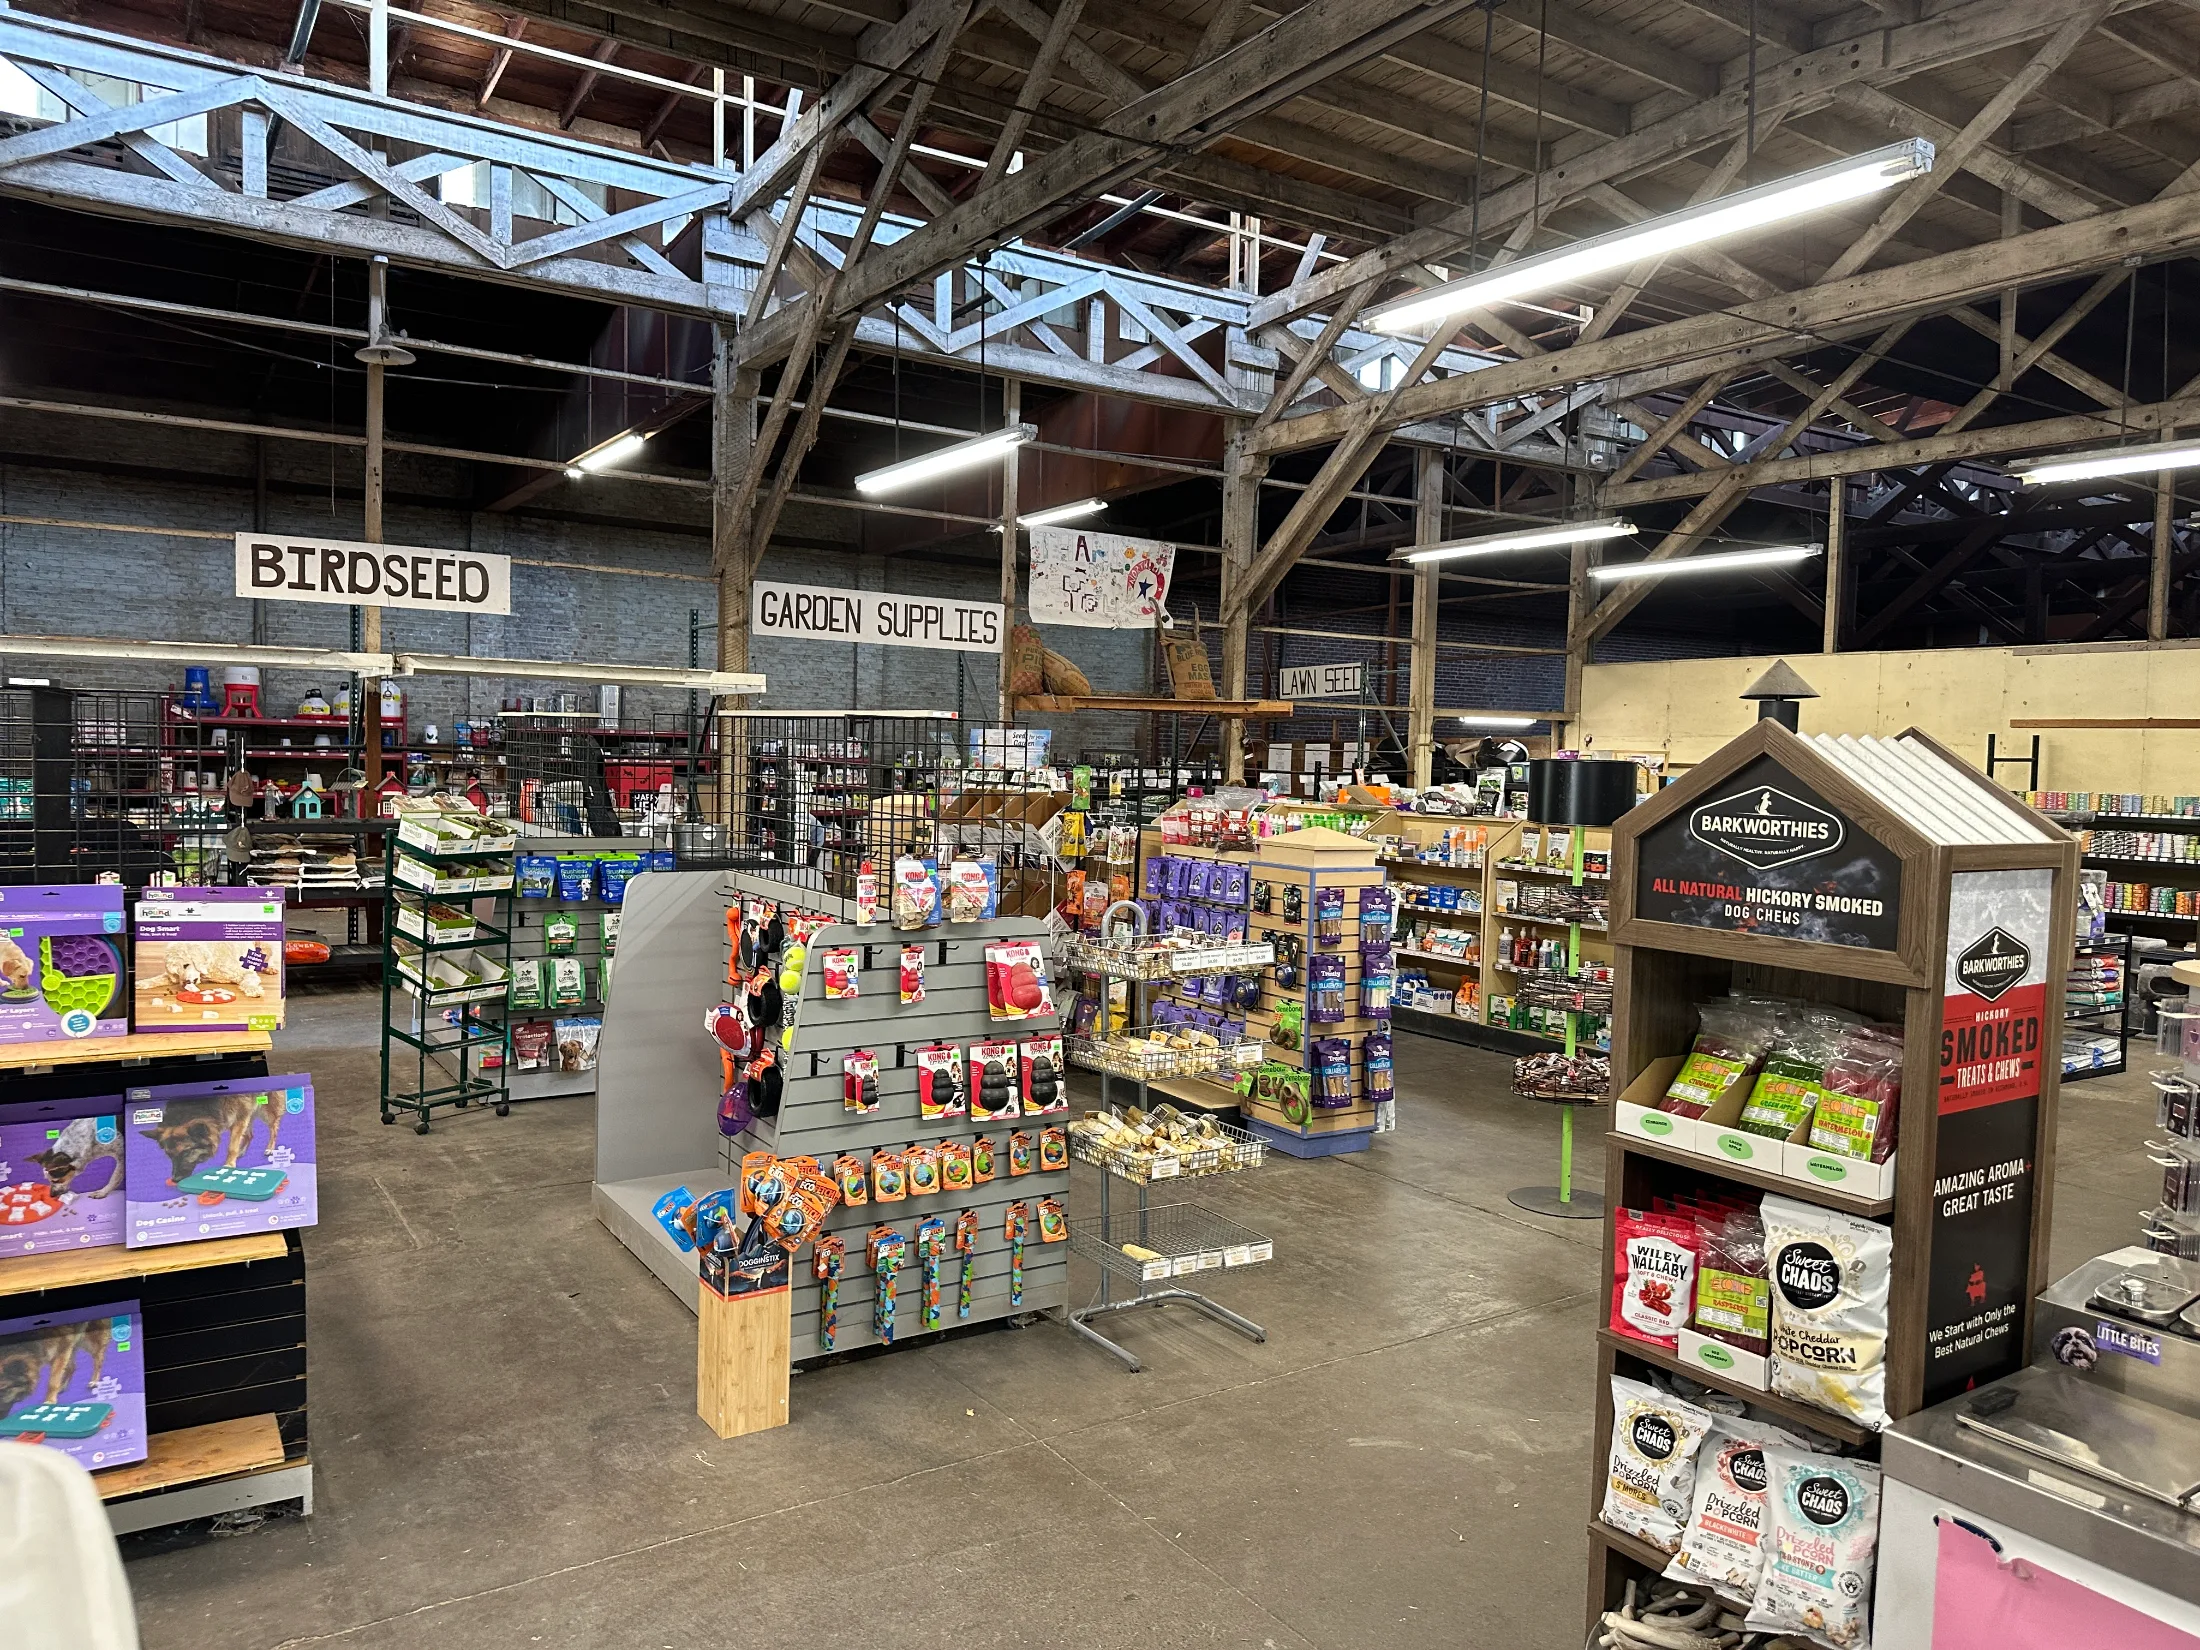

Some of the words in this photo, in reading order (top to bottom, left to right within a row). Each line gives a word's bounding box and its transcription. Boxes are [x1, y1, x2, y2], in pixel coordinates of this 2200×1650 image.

[251, 544, 490, 603] BIRDSEED
[761, 590, 862, 634] GARDEN
[877, 601, 998, 645] SUPPLIES
[1281, 669, 1317, 696] LAWN
[1325, 666, 1361, 693] SEED
[1701, 815, 1829, 840] BARKWORTHIES
[905, 871, 925, 880] KONG
[961, 872, 981, 880] KONG
[1653, 878, 1676, 894] ALL
[1679, 880, 1742, 902] NATURAL
[1745, 887, 1813, 909] HICKORY
[1815, 894, 1883, 917] SMOKED
[1724, 904, 1750, 919] DOG
[1756, 908, 1801, 925] CHEWS
[140, 925, 156, 933] Dog
[1005, 948, 1025, 958] KONG
[1962, 954, 2025, 975] BARKWORTHIES
[1975, 1007, 2010, 1022] HICKORY
[981, 1047, 1000, 1056] KONG
[1029, 1042, 1046, 1052] KONG
[1941, 1016, 2039, 1067] SMOKED
[927, 1052, 946, 1062] KONG
[1957, 1062, 1987, 1089] TREATS
[1994, 1057, 2021, 1080] CHEWS
[1760, 1099, 1780, 1109] GREEN
[1779, 1102, 1798, 1111] APPLE
[1817, 1119, 1864, 1139] WATERMELON
[1809, 1161, 1844, 1174] WATERMELON
[1933, 1168, 1985, 1197] AMAZING
[1988, 1158, 2024, 1183] AROMA
[799, 1178, 838, 1200] ECOFETCH
[1943, 1193, 1978, 1217] GREAT
[1982, 1182, 2014, 1207] TASTE
[788, 1192, 822, 1223] ECOFETCH
[136, 1219, 155, 1228] Dog
[1635, 1224, 1655, 1233] REALLY
[1637, 1245, 1682, 1263] WILEY
[1784, 1248, 1834, 1274] Sweet
[1631, 1253, 1689, 1282] WALLABY
[1637, 1269, 1650, 1277] SOFT
[1656, 1273, 1678, 1284] CHEWY
[1781, 1263, 1834, 1294] CHAOS
[1634, 1312, 1659, 1323] CLASSIC
[1658, 1318, 1670, 1326] RED
[1929, 1331, 1943, 1343] We
[1944, 1325, 1965, 1340] Start
[1966, 1315, 1983, 1332] with
[1984, 1309, 2002, 1326] Only
[2003, 1303, 2016, 1318] the
[1773, 1327, 1857, 1364] POPCORN
[1798, 1330, 1841, 1344] Cheddar
[1934, 1344, 1953, 1359] Best
[1954, 1333, 1983, 1353] Natural
[1984, 1325, 2010, 1342] Chews
[2096, 1324, 2127, 1347] LITTLE
[2129, 1335, 2160, 1357] BITES
[1636, 1427, 1671, 1451] CHAOS
[1640, 1418, 1671, 1438] Sweet
[1614, 1455, 1660, 1487] Drizzled
[1738, 1454, 1765, 1468] Swee
[1613, 1466, 1657, 1496] POPCORN
[1616, 1480, 1646, 1500] S'MORES
[1806, 1483, 1843, 1499] Sweet
[1707, 1493, 1761, 1520] Drizzled
[1801, 1491, 1842, 1515] CHAOS
[1705, 1504, 1759, 1529] POPCORN
[1776, 1526, 1835, 1556] Drizzled
[1776, 1539, 1835, 1567] POPCORN
